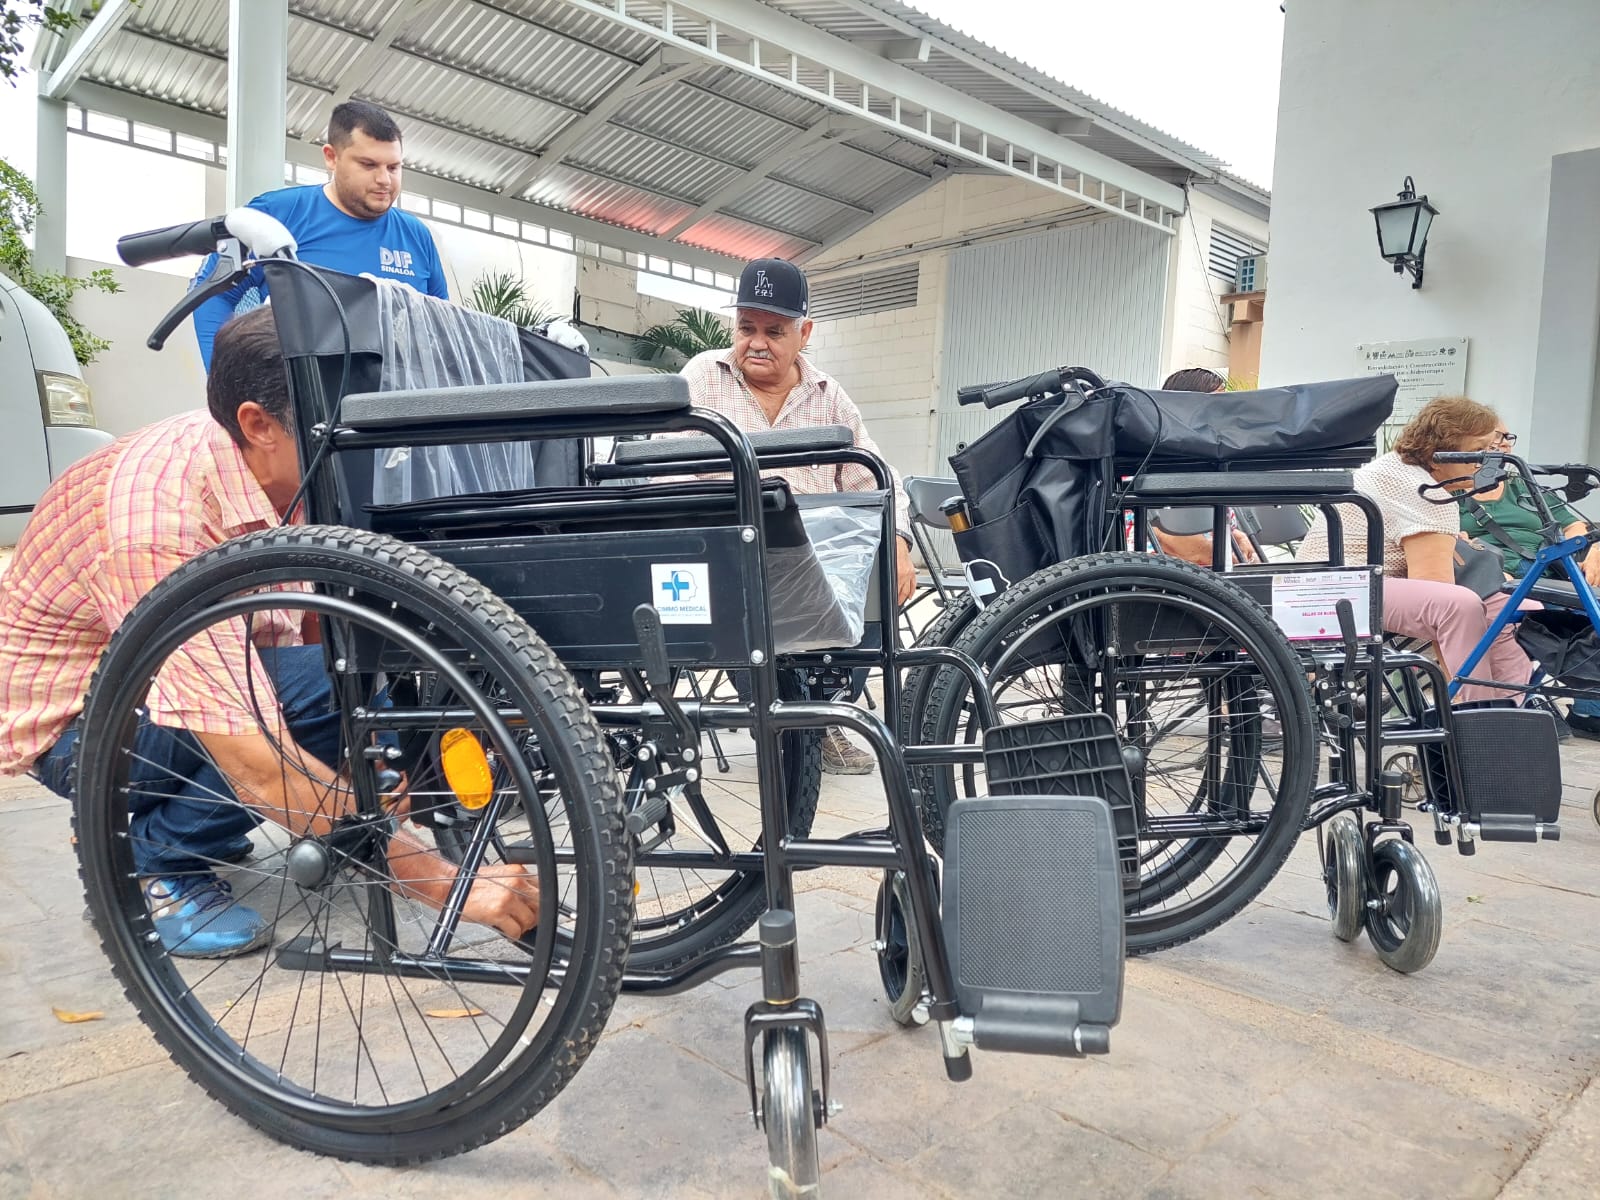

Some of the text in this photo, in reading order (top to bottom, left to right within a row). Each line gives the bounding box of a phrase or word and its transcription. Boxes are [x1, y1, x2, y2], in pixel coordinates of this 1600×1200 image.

[379, 246, 413, 269] DIF
[380, 265, 416, 277] SINALOA
[754, 270, 774, 298] LA
